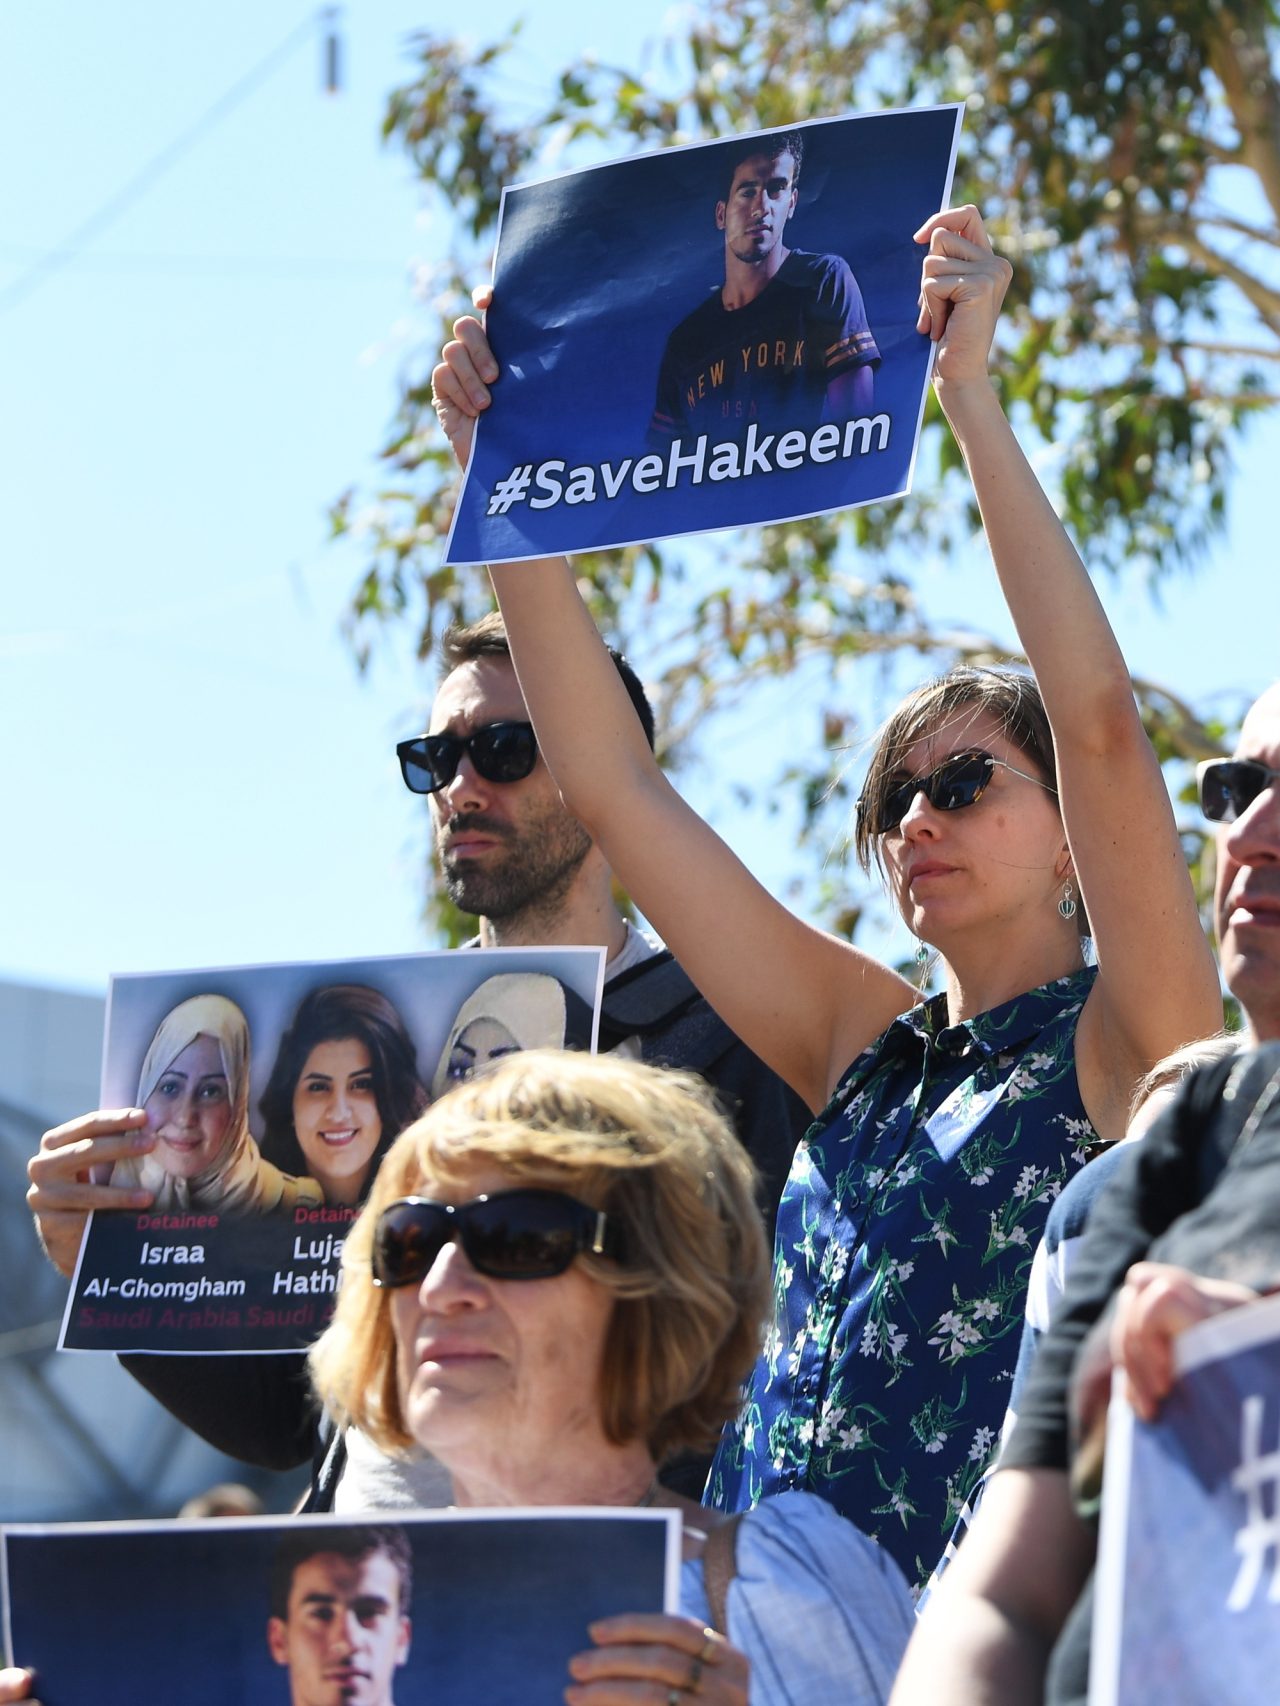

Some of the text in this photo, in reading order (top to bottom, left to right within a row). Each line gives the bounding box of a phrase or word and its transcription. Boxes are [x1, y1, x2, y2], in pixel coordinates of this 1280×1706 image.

[687, 340, 805, 411] NEW YORK
[722, 400, 758, 418] USA
[485, 413, 891, 516] #SaveHakeem
[136, 1212, 219, 1231] Detainee
[140, 1242, 206, 1265] Israa
[83, 1275, 246, 1303] Al-Ghomgham
[79, 1304, 241, 1328] Saudi Arabia
[246, 1303, 314, 1328] Saudi
